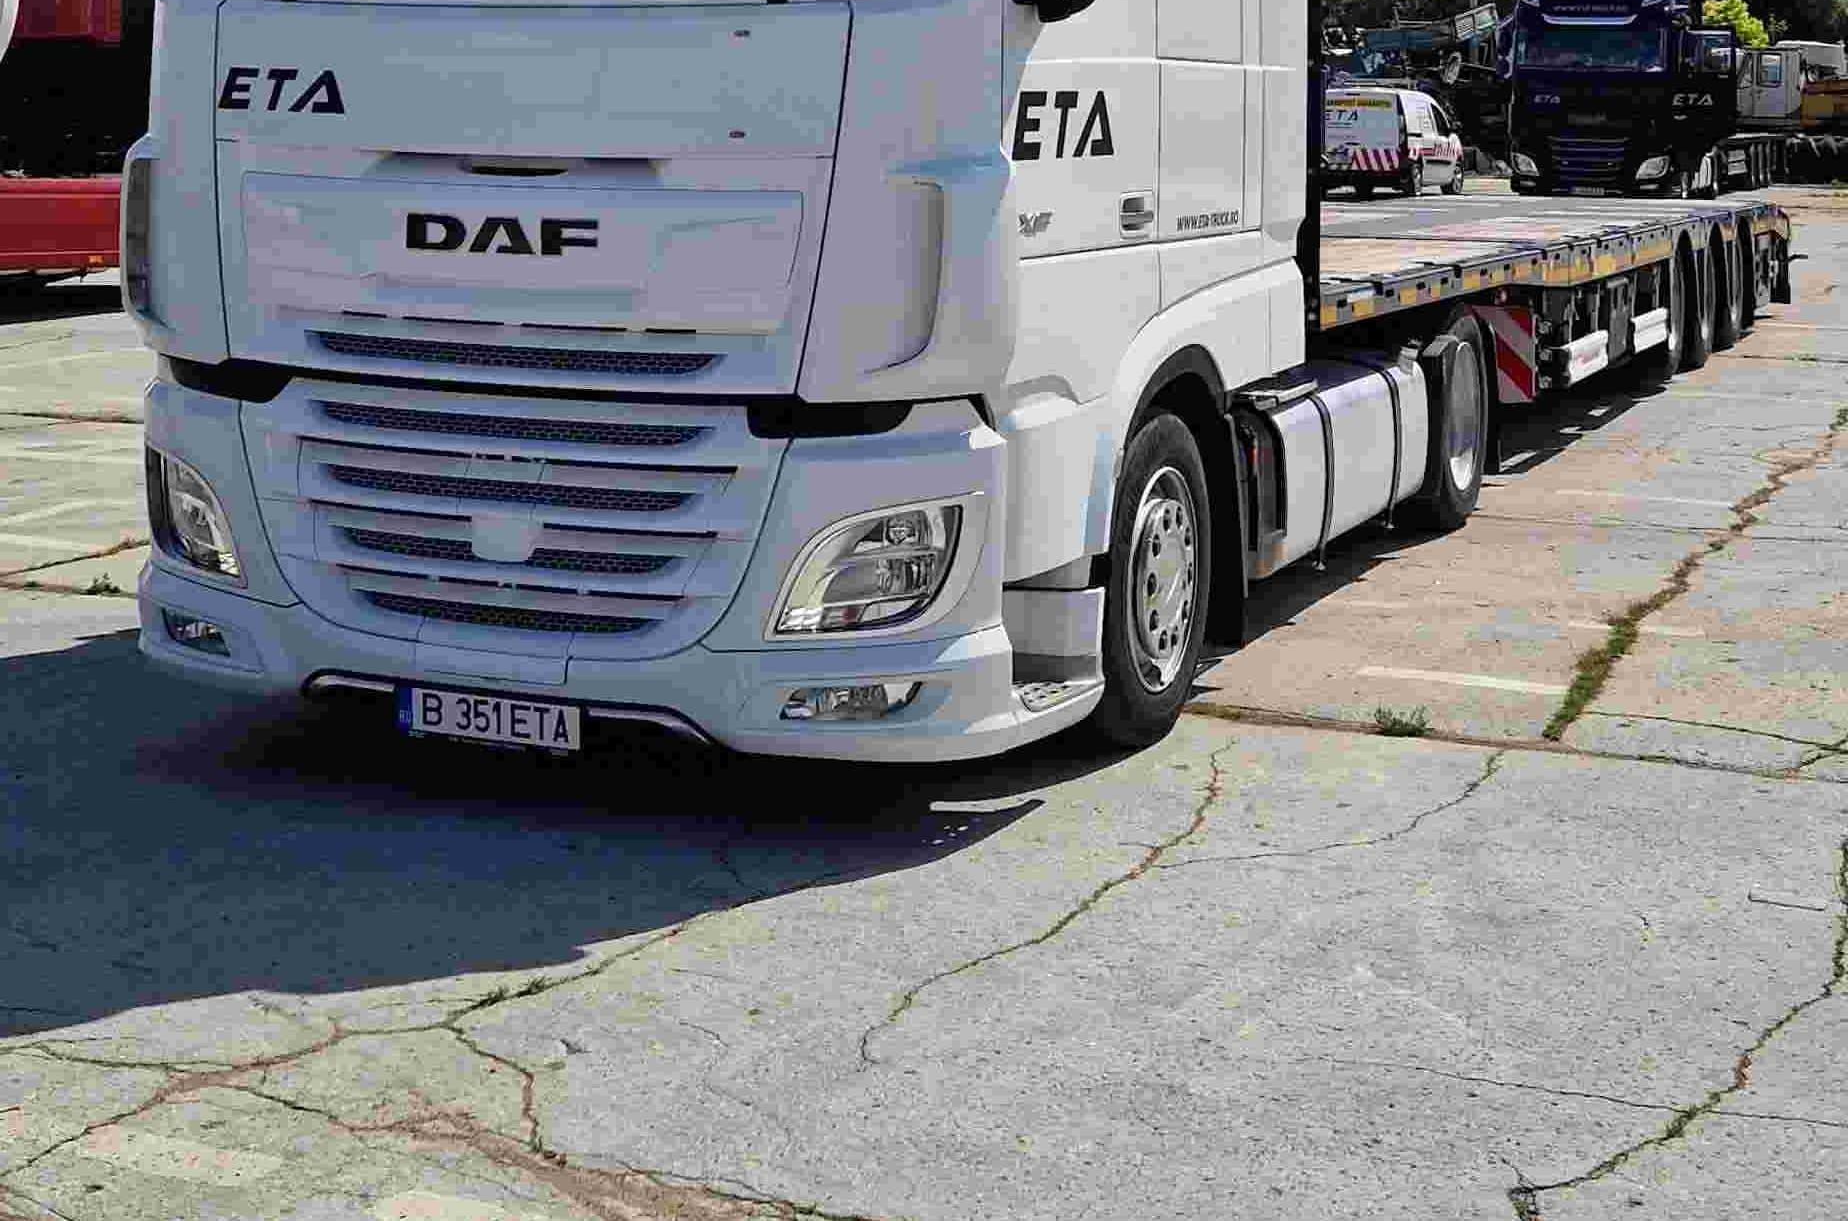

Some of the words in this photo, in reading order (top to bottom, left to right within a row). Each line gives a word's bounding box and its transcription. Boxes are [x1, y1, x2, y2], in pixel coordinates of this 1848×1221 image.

[217, 66, 345, 114] ETA
[1533, 94, 1561, 104] ETA
[1671, 93, 1713, 106] ETA
[1011, 90, 1115, 161] ETA
[405, 213, 600, 256] DAF
[422, 692, 443, 726] B
